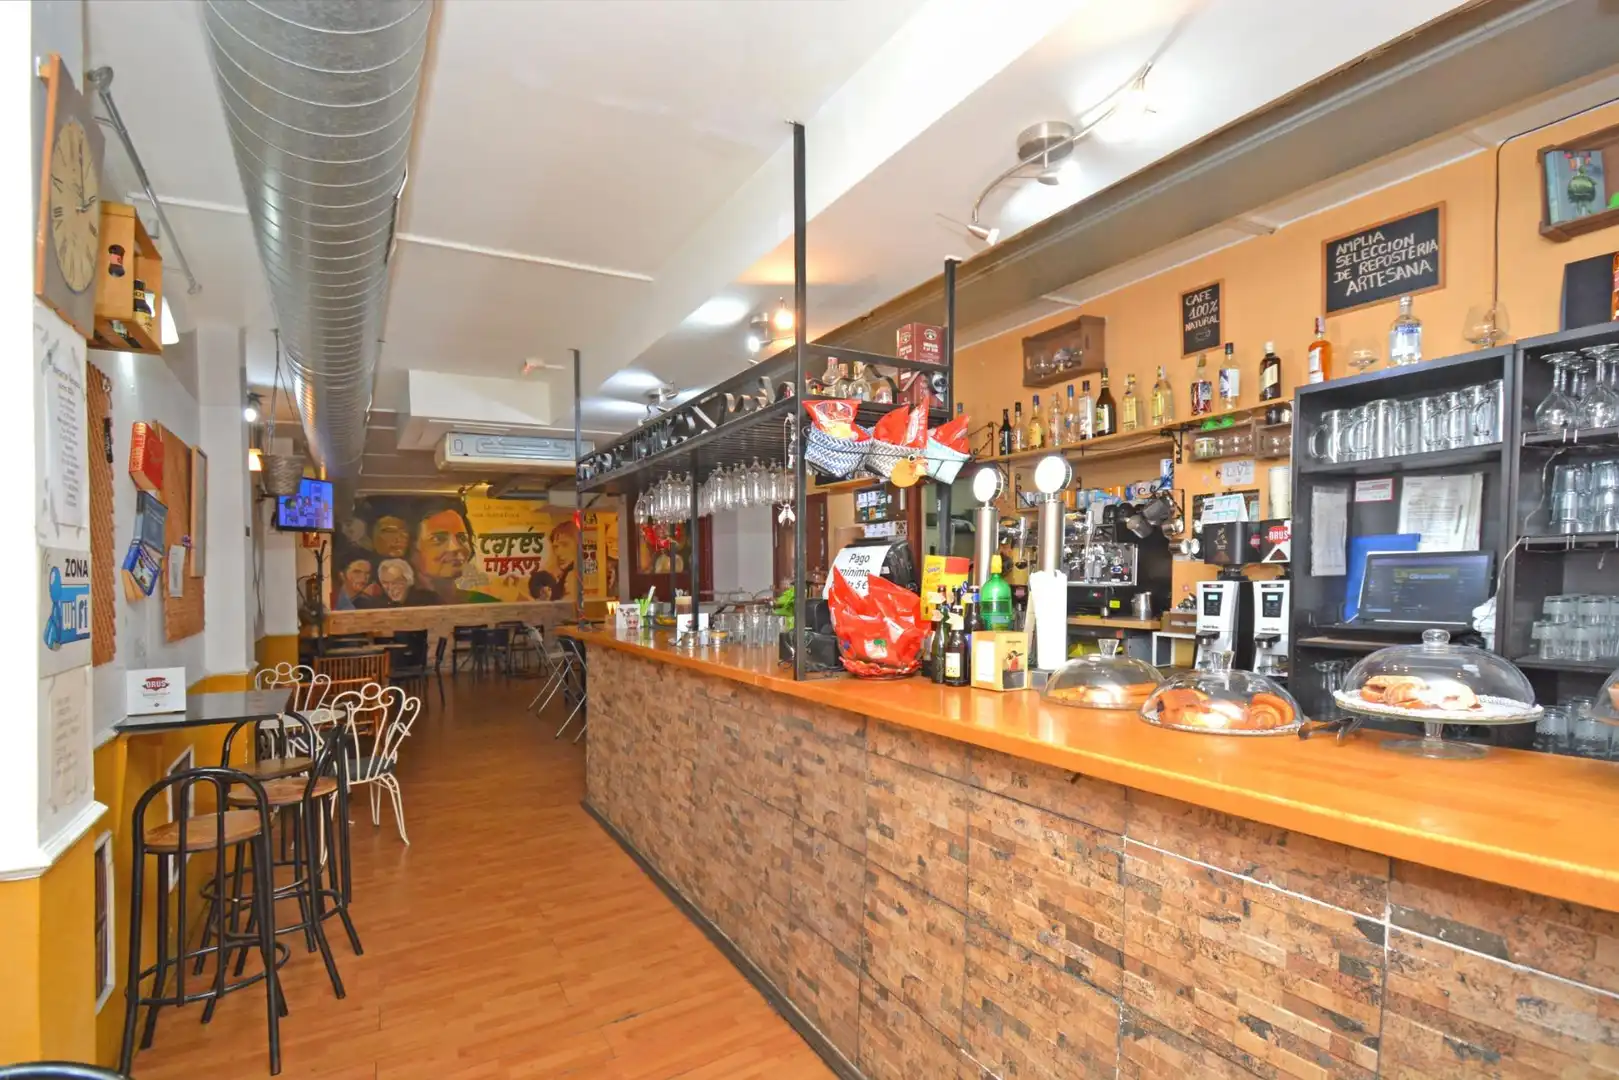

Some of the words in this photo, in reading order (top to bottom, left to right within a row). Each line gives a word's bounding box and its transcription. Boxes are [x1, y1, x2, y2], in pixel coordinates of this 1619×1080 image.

[1335, 231, 1386, 257] AMPLIA
[1335, 233, 1415, 269] SELECCION
[1333, 268, 1353, 284] DE
[1359, 239, 1439, 275] REPOSTERIA
[1345, 259, 1434, 297] ARTESANA
[1185, 289, 1213, 307] CAFE
[1188, 299, 1219, 320] 100%
[1184, 314, 1220, 333] NATURAL
[65, 558, 89, 578] ZONA
[848, 553, 871, 566] Pago
